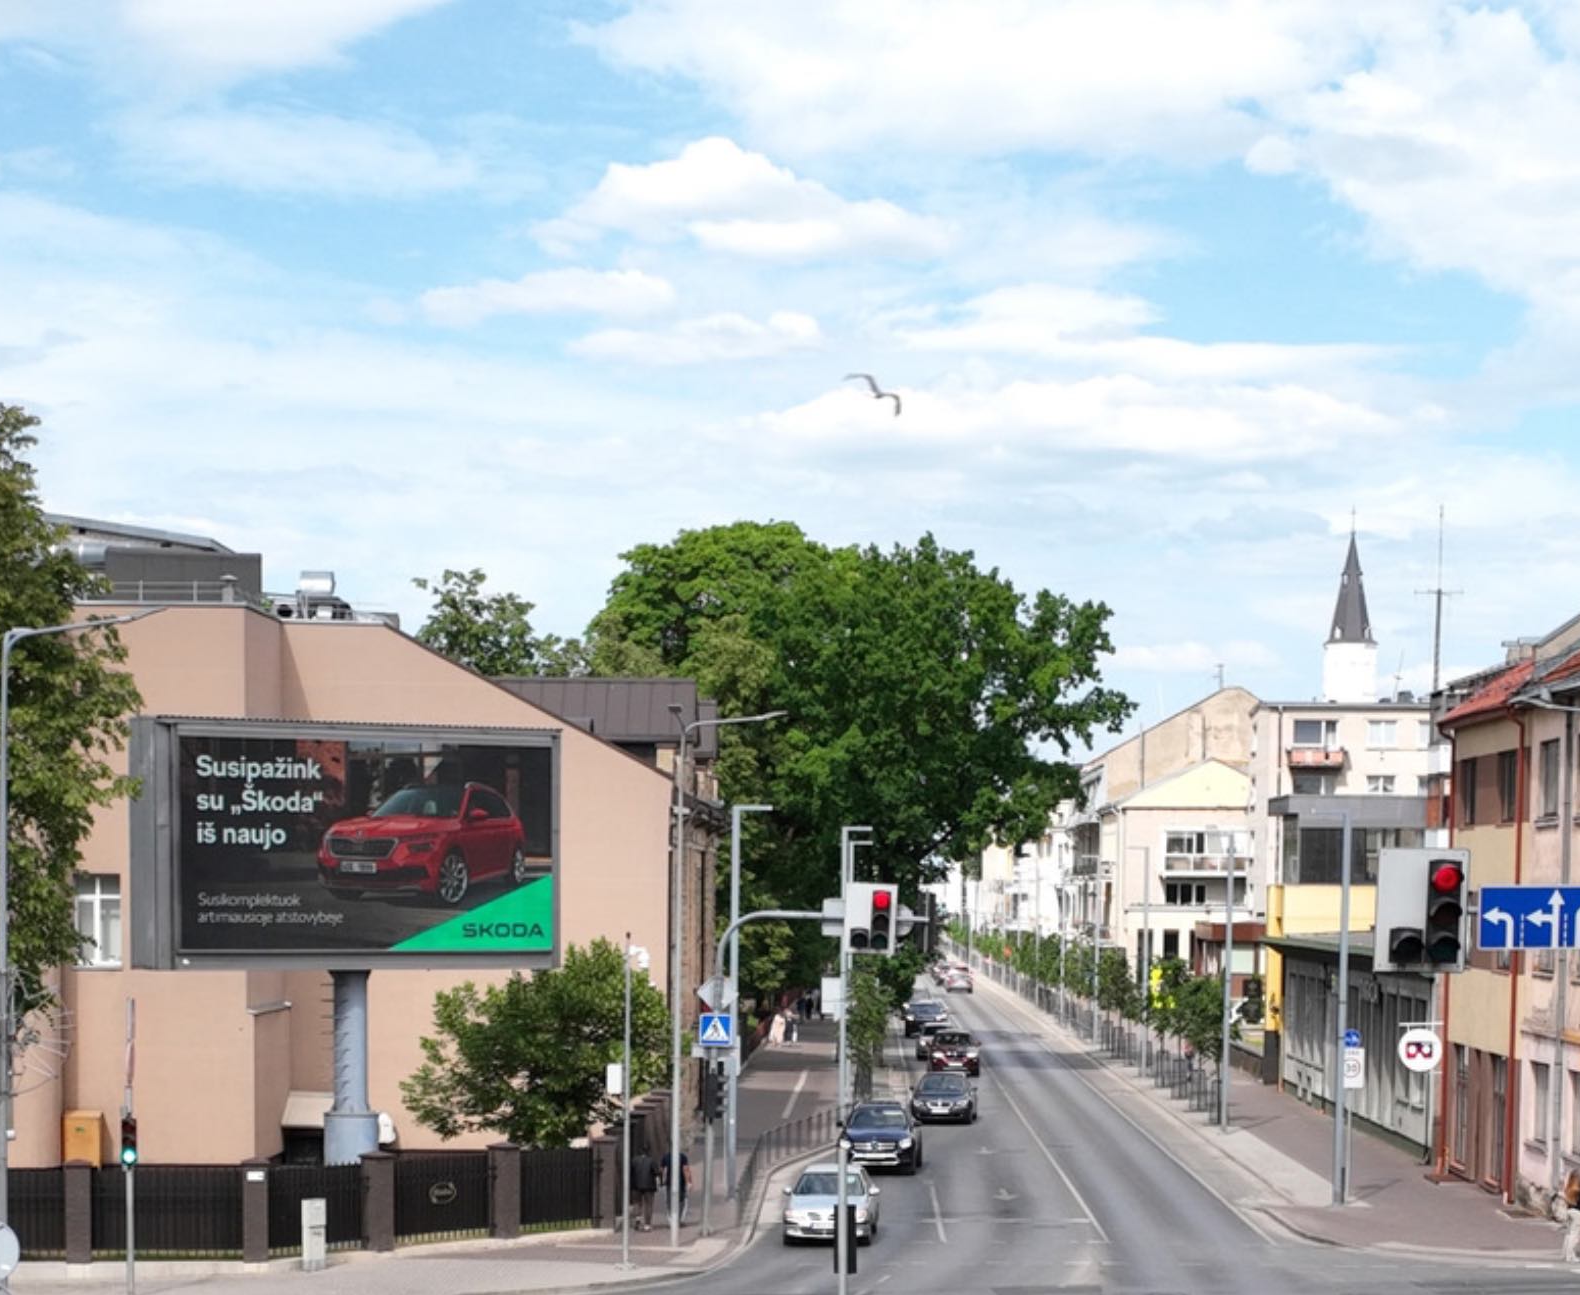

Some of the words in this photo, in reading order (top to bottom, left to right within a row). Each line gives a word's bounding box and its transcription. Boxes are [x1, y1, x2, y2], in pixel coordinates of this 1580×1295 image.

[196, 755, 322, 782] Susipažink
[196, 793, 224, 811] su
[196, 822, 216, 844] iš
[223, 823, 287, 850] naujo
